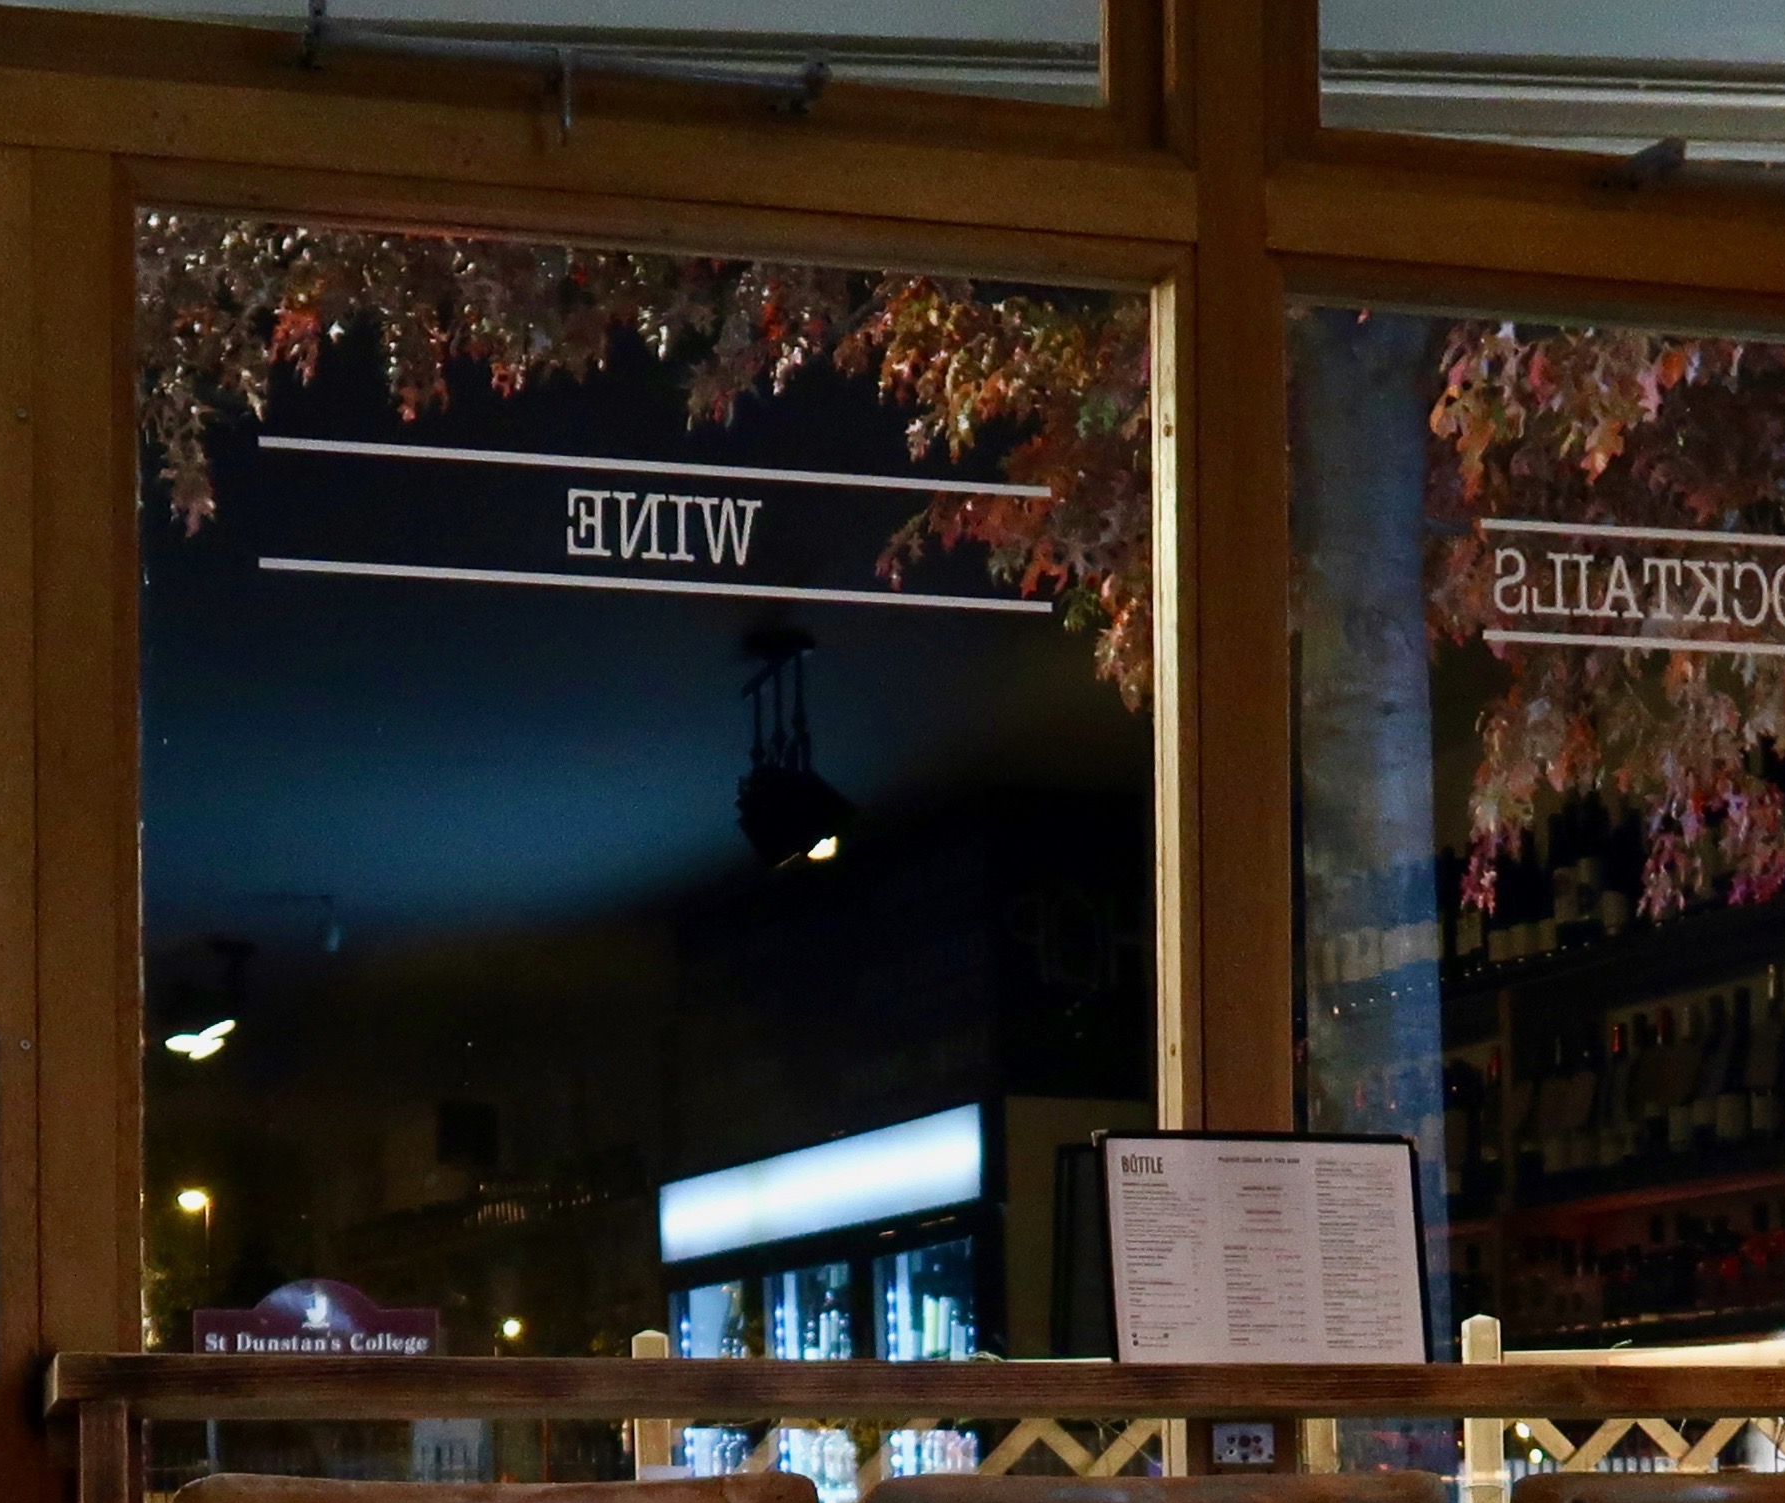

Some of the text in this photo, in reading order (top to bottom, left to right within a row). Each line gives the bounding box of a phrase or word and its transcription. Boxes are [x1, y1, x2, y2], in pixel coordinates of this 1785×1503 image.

[205, 1331, 430, 1354] St Dunstan's College
